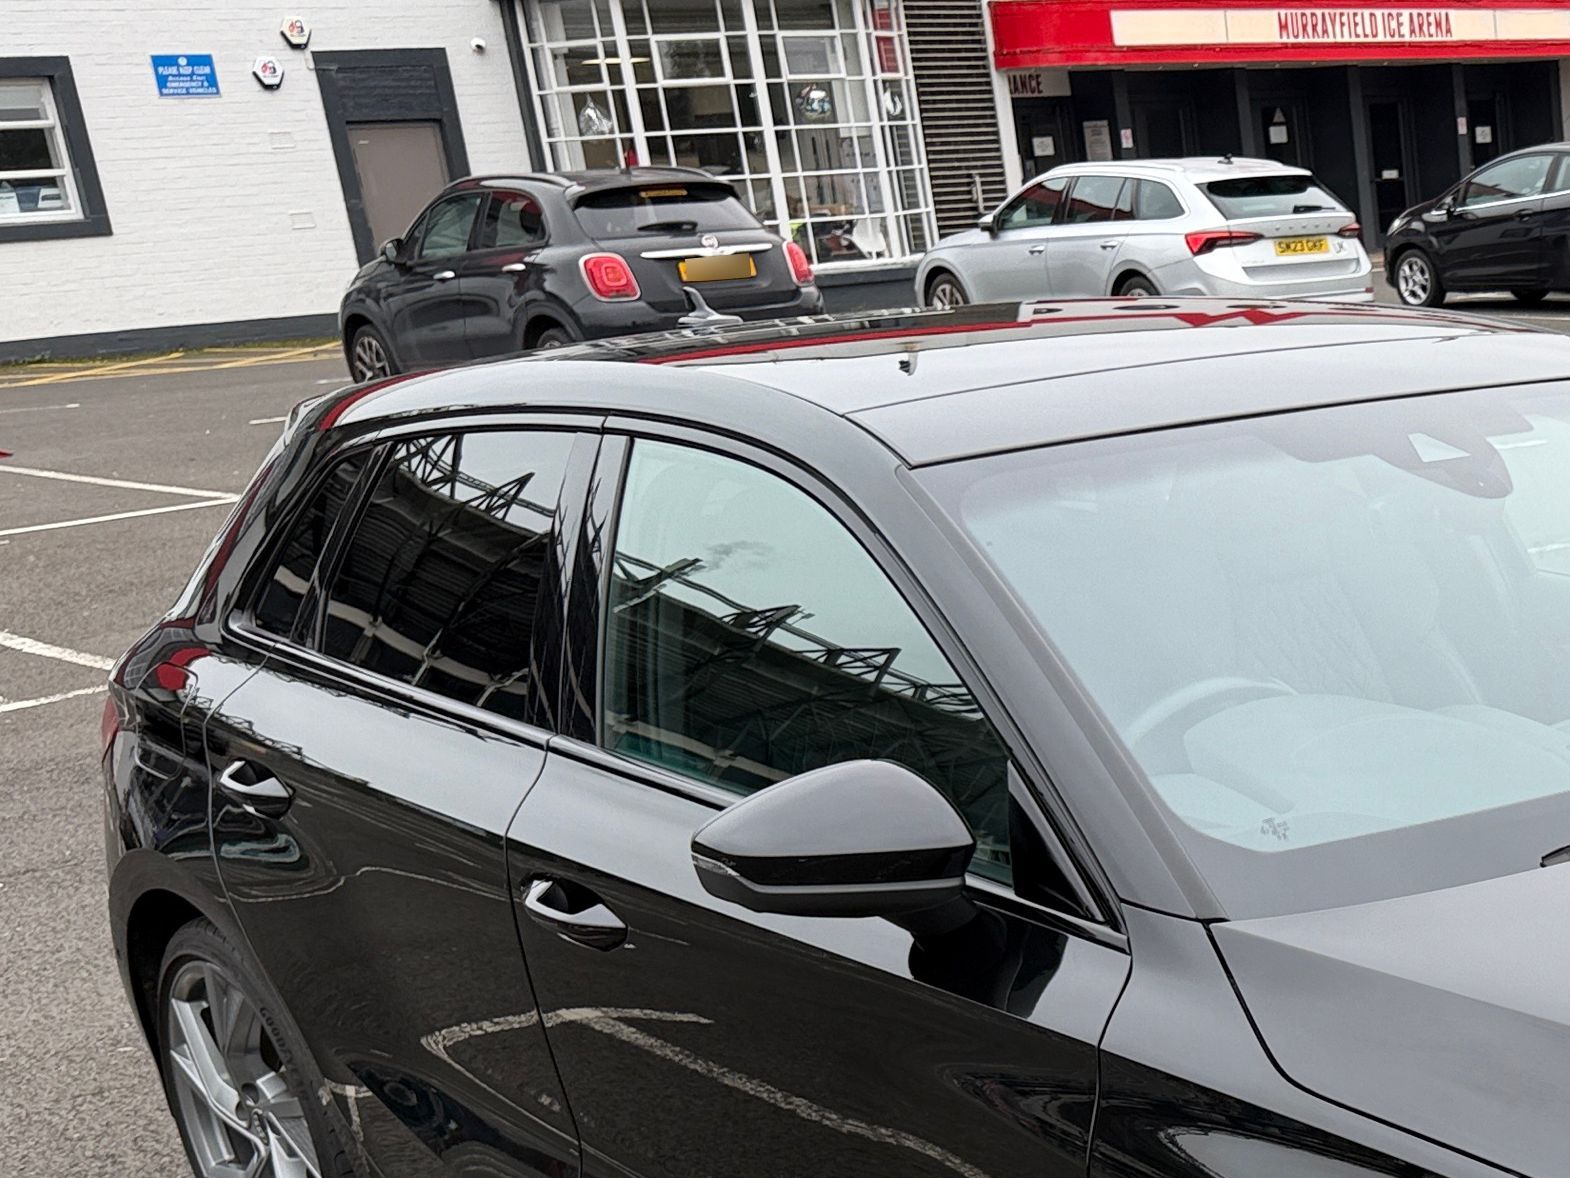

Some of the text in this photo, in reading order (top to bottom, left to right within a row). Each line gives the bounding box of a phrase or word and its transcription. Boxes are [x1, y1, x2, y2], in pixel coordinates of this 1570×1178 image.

[1277, 11, 1453, 39] MURRAYFIELD ICE ARENA
